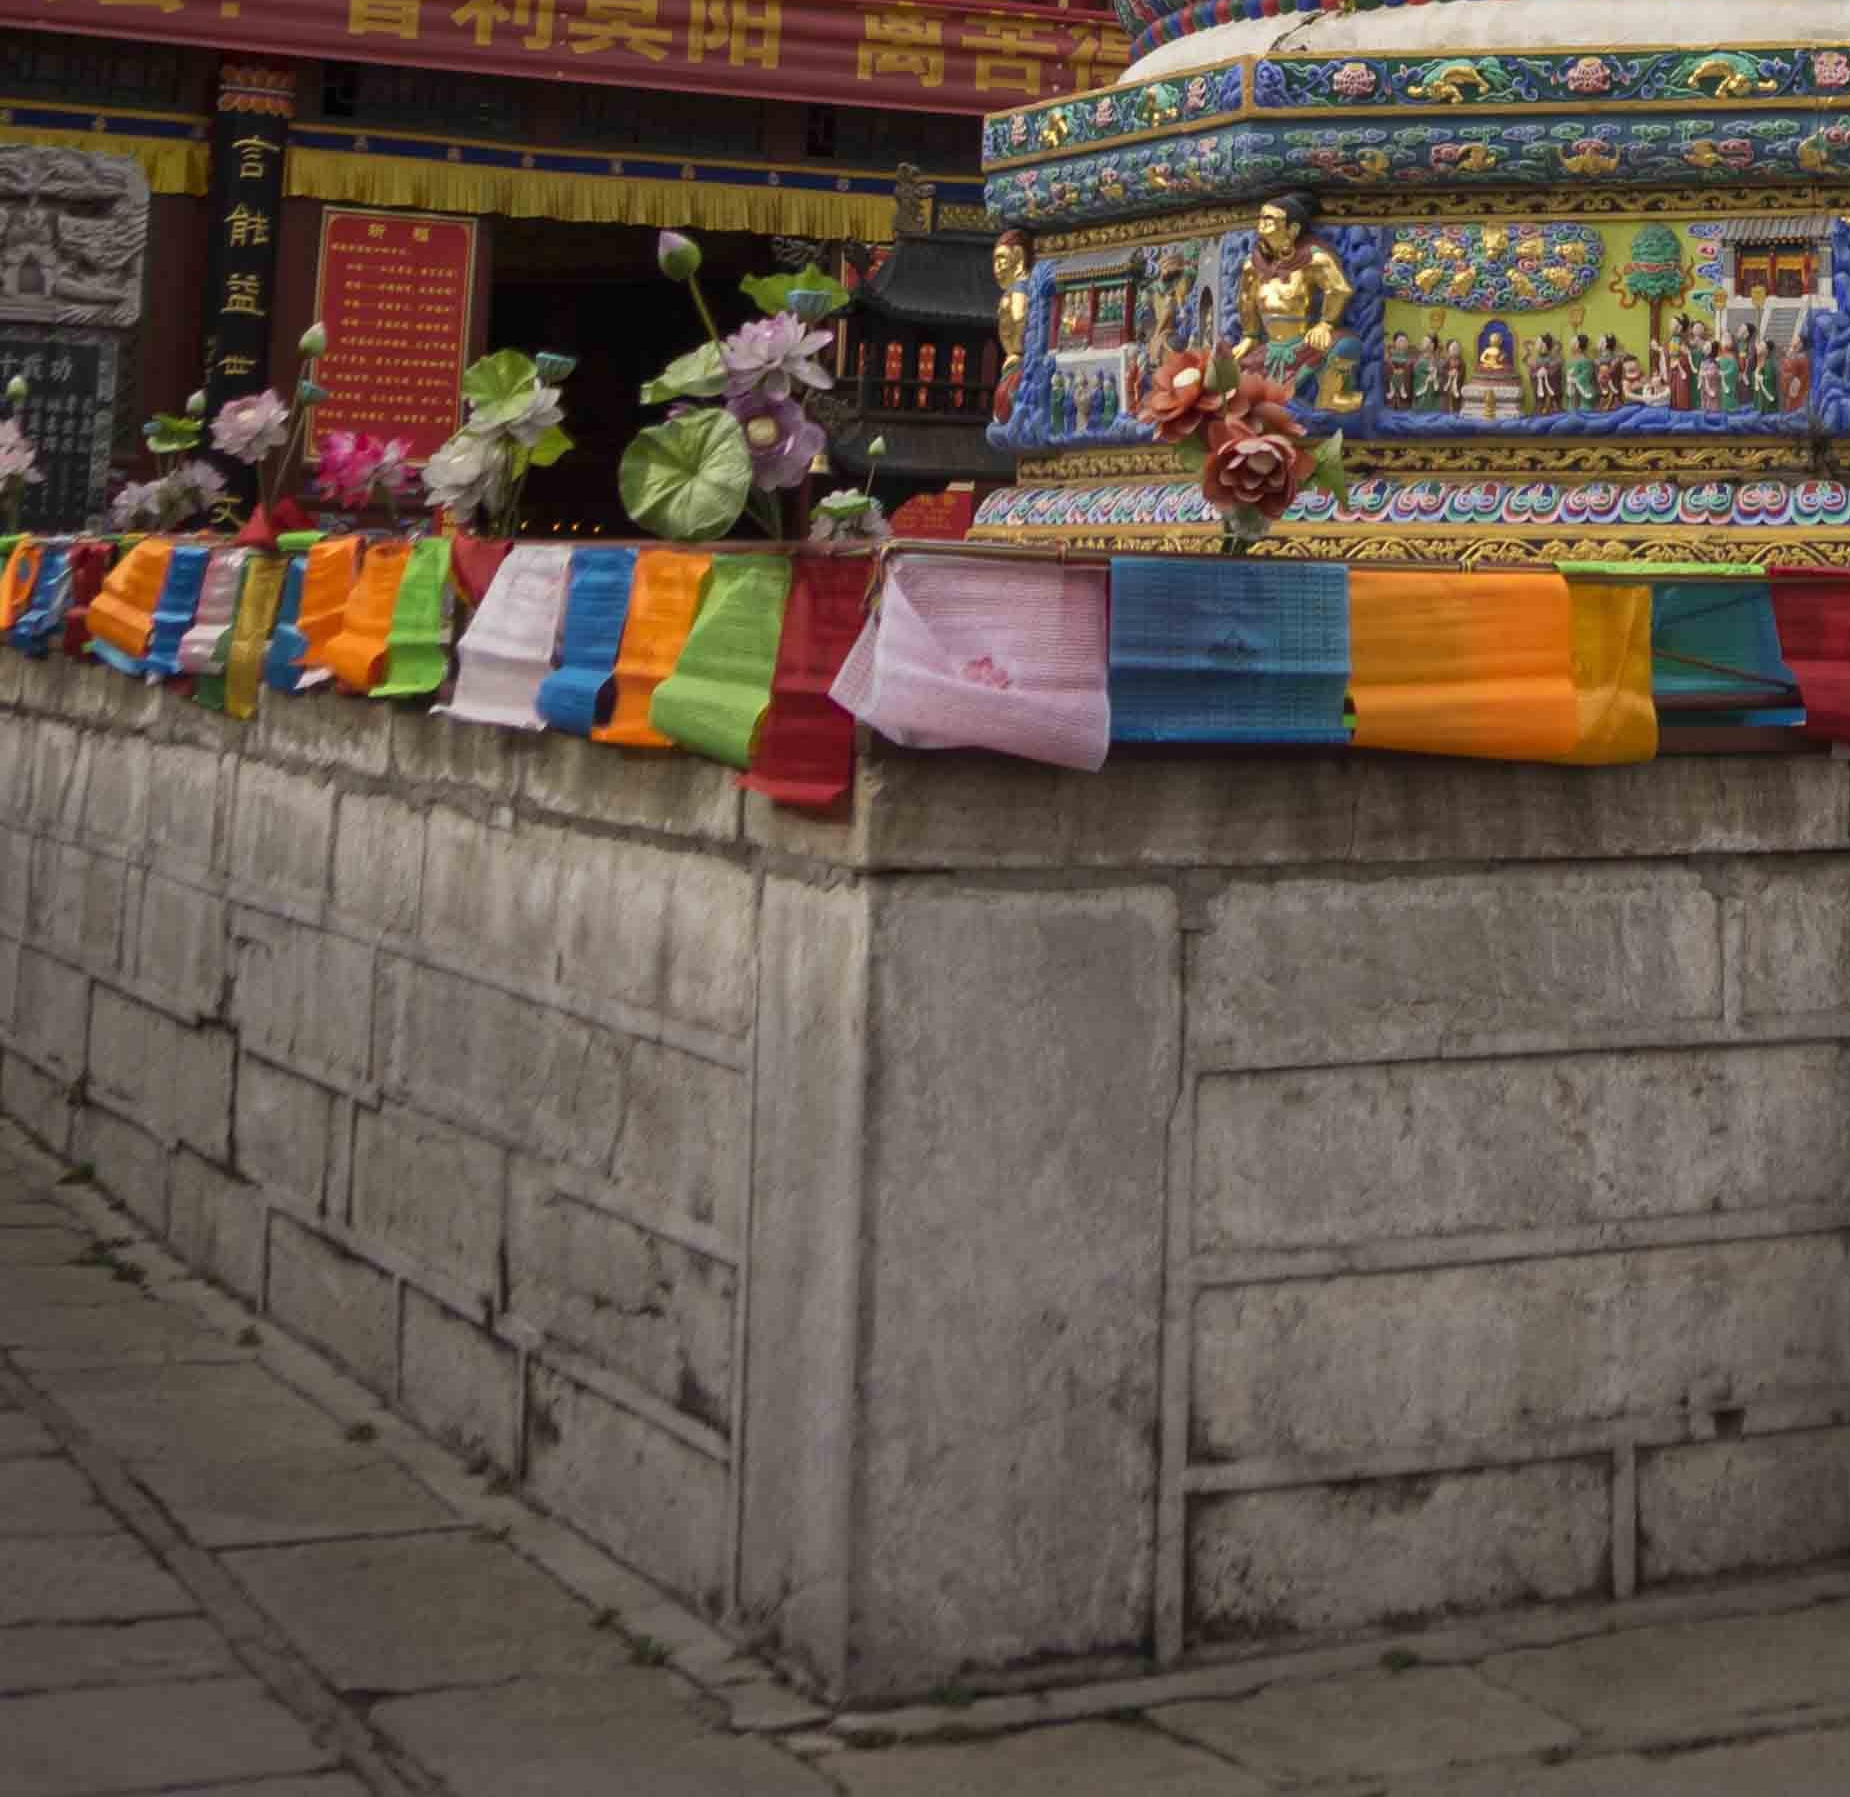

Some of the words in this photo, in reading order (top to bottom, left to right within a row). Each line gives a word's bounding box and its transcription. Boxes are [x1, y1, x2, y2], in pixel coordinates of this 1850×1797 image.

[209, 134, 281, 529] 言能益世文
